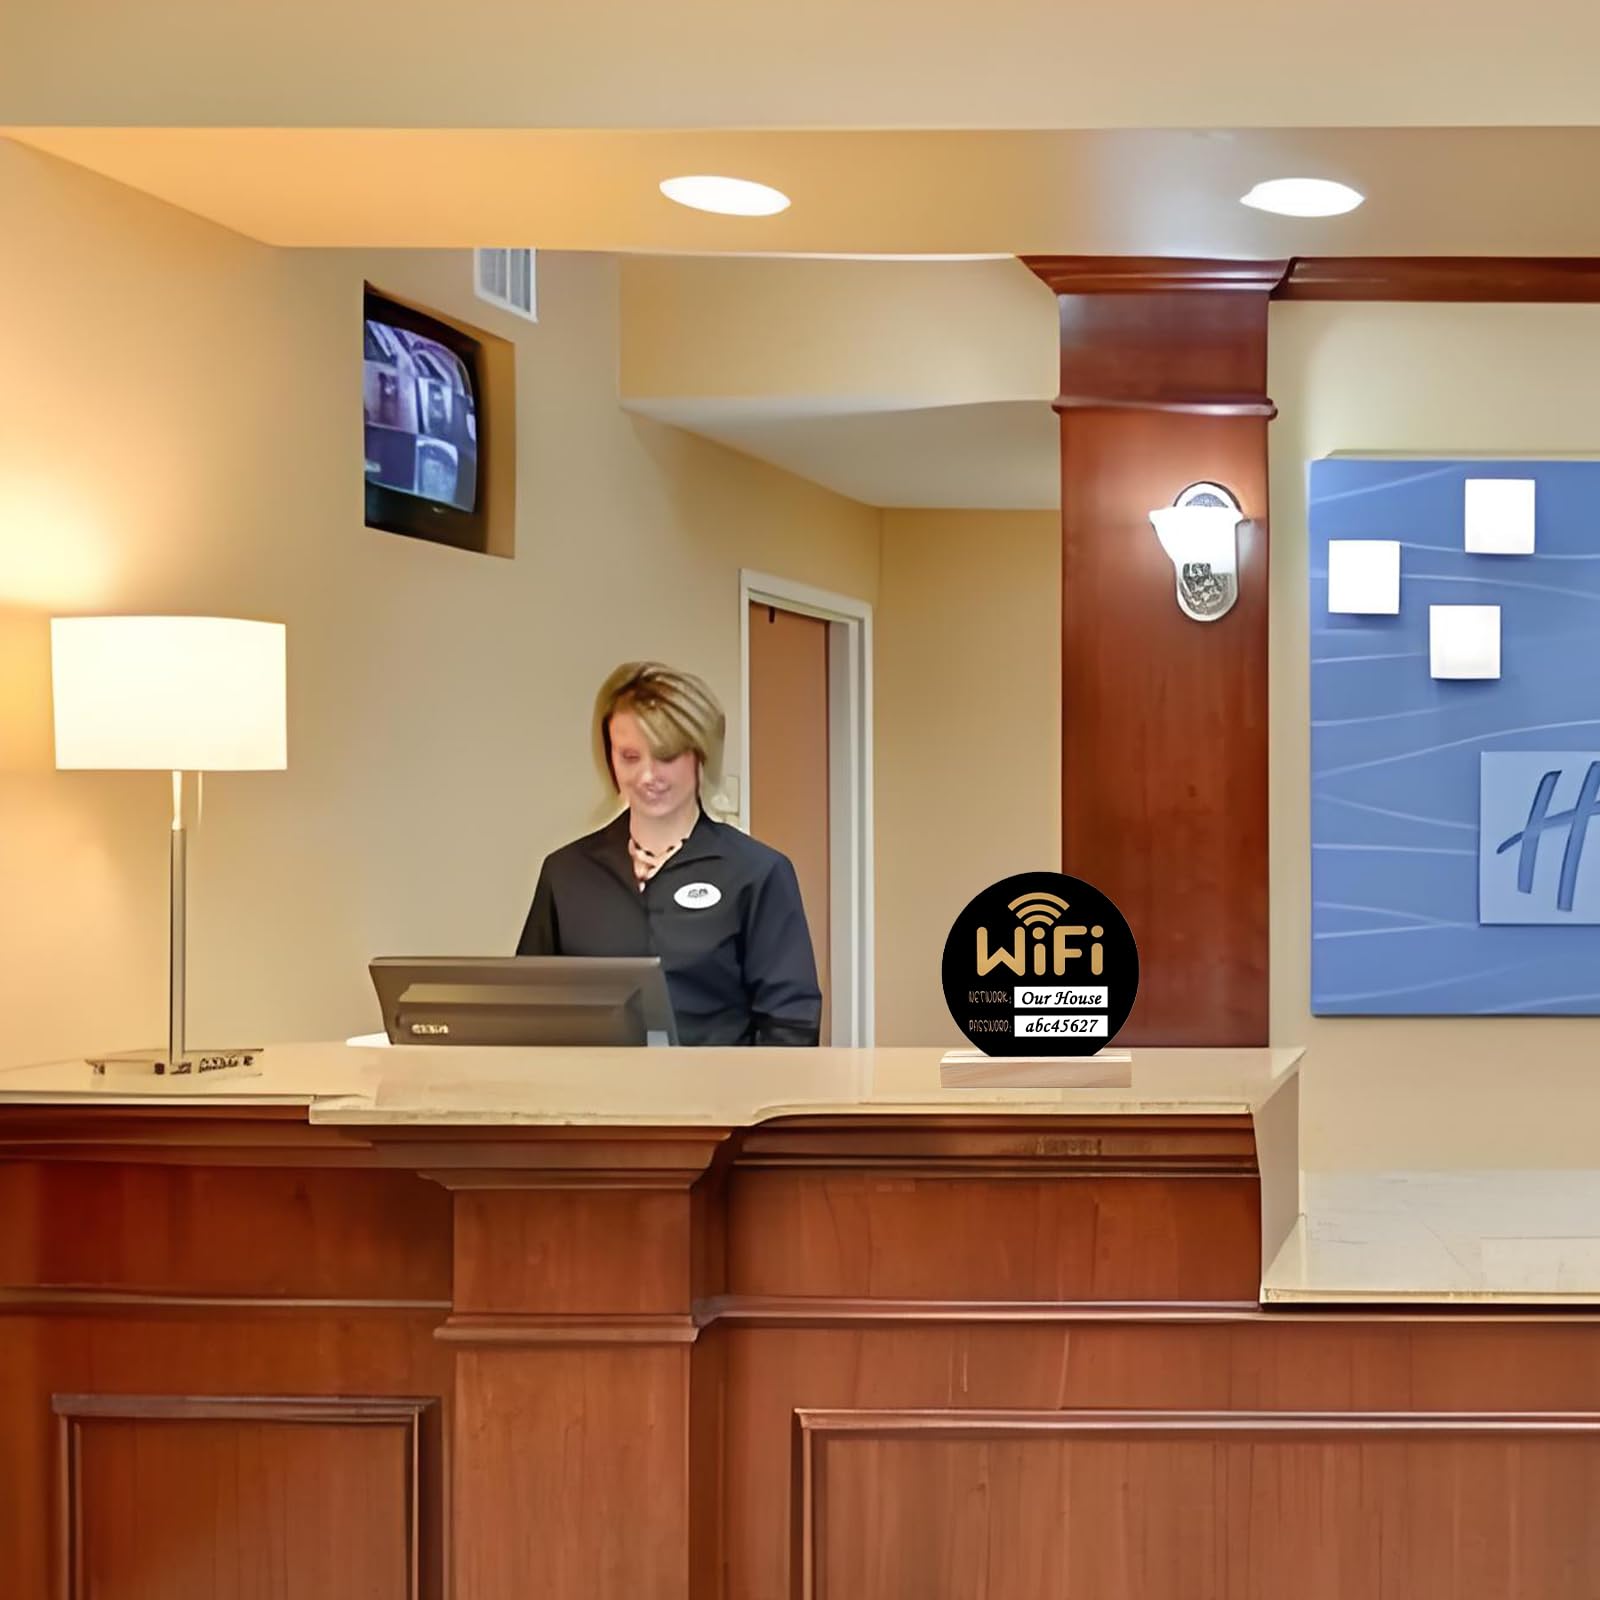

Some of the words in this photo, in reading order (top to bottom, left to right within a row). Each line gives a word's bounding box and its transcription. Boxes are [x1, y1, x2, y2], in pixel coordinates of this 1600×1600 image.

[976, 925, 1104, 976] WiFi
[1021, 991, 1051, 1005] Our
[1054, 991, 1102, 1005] House
[1025, 1017, 1099, 1033] abc45627
